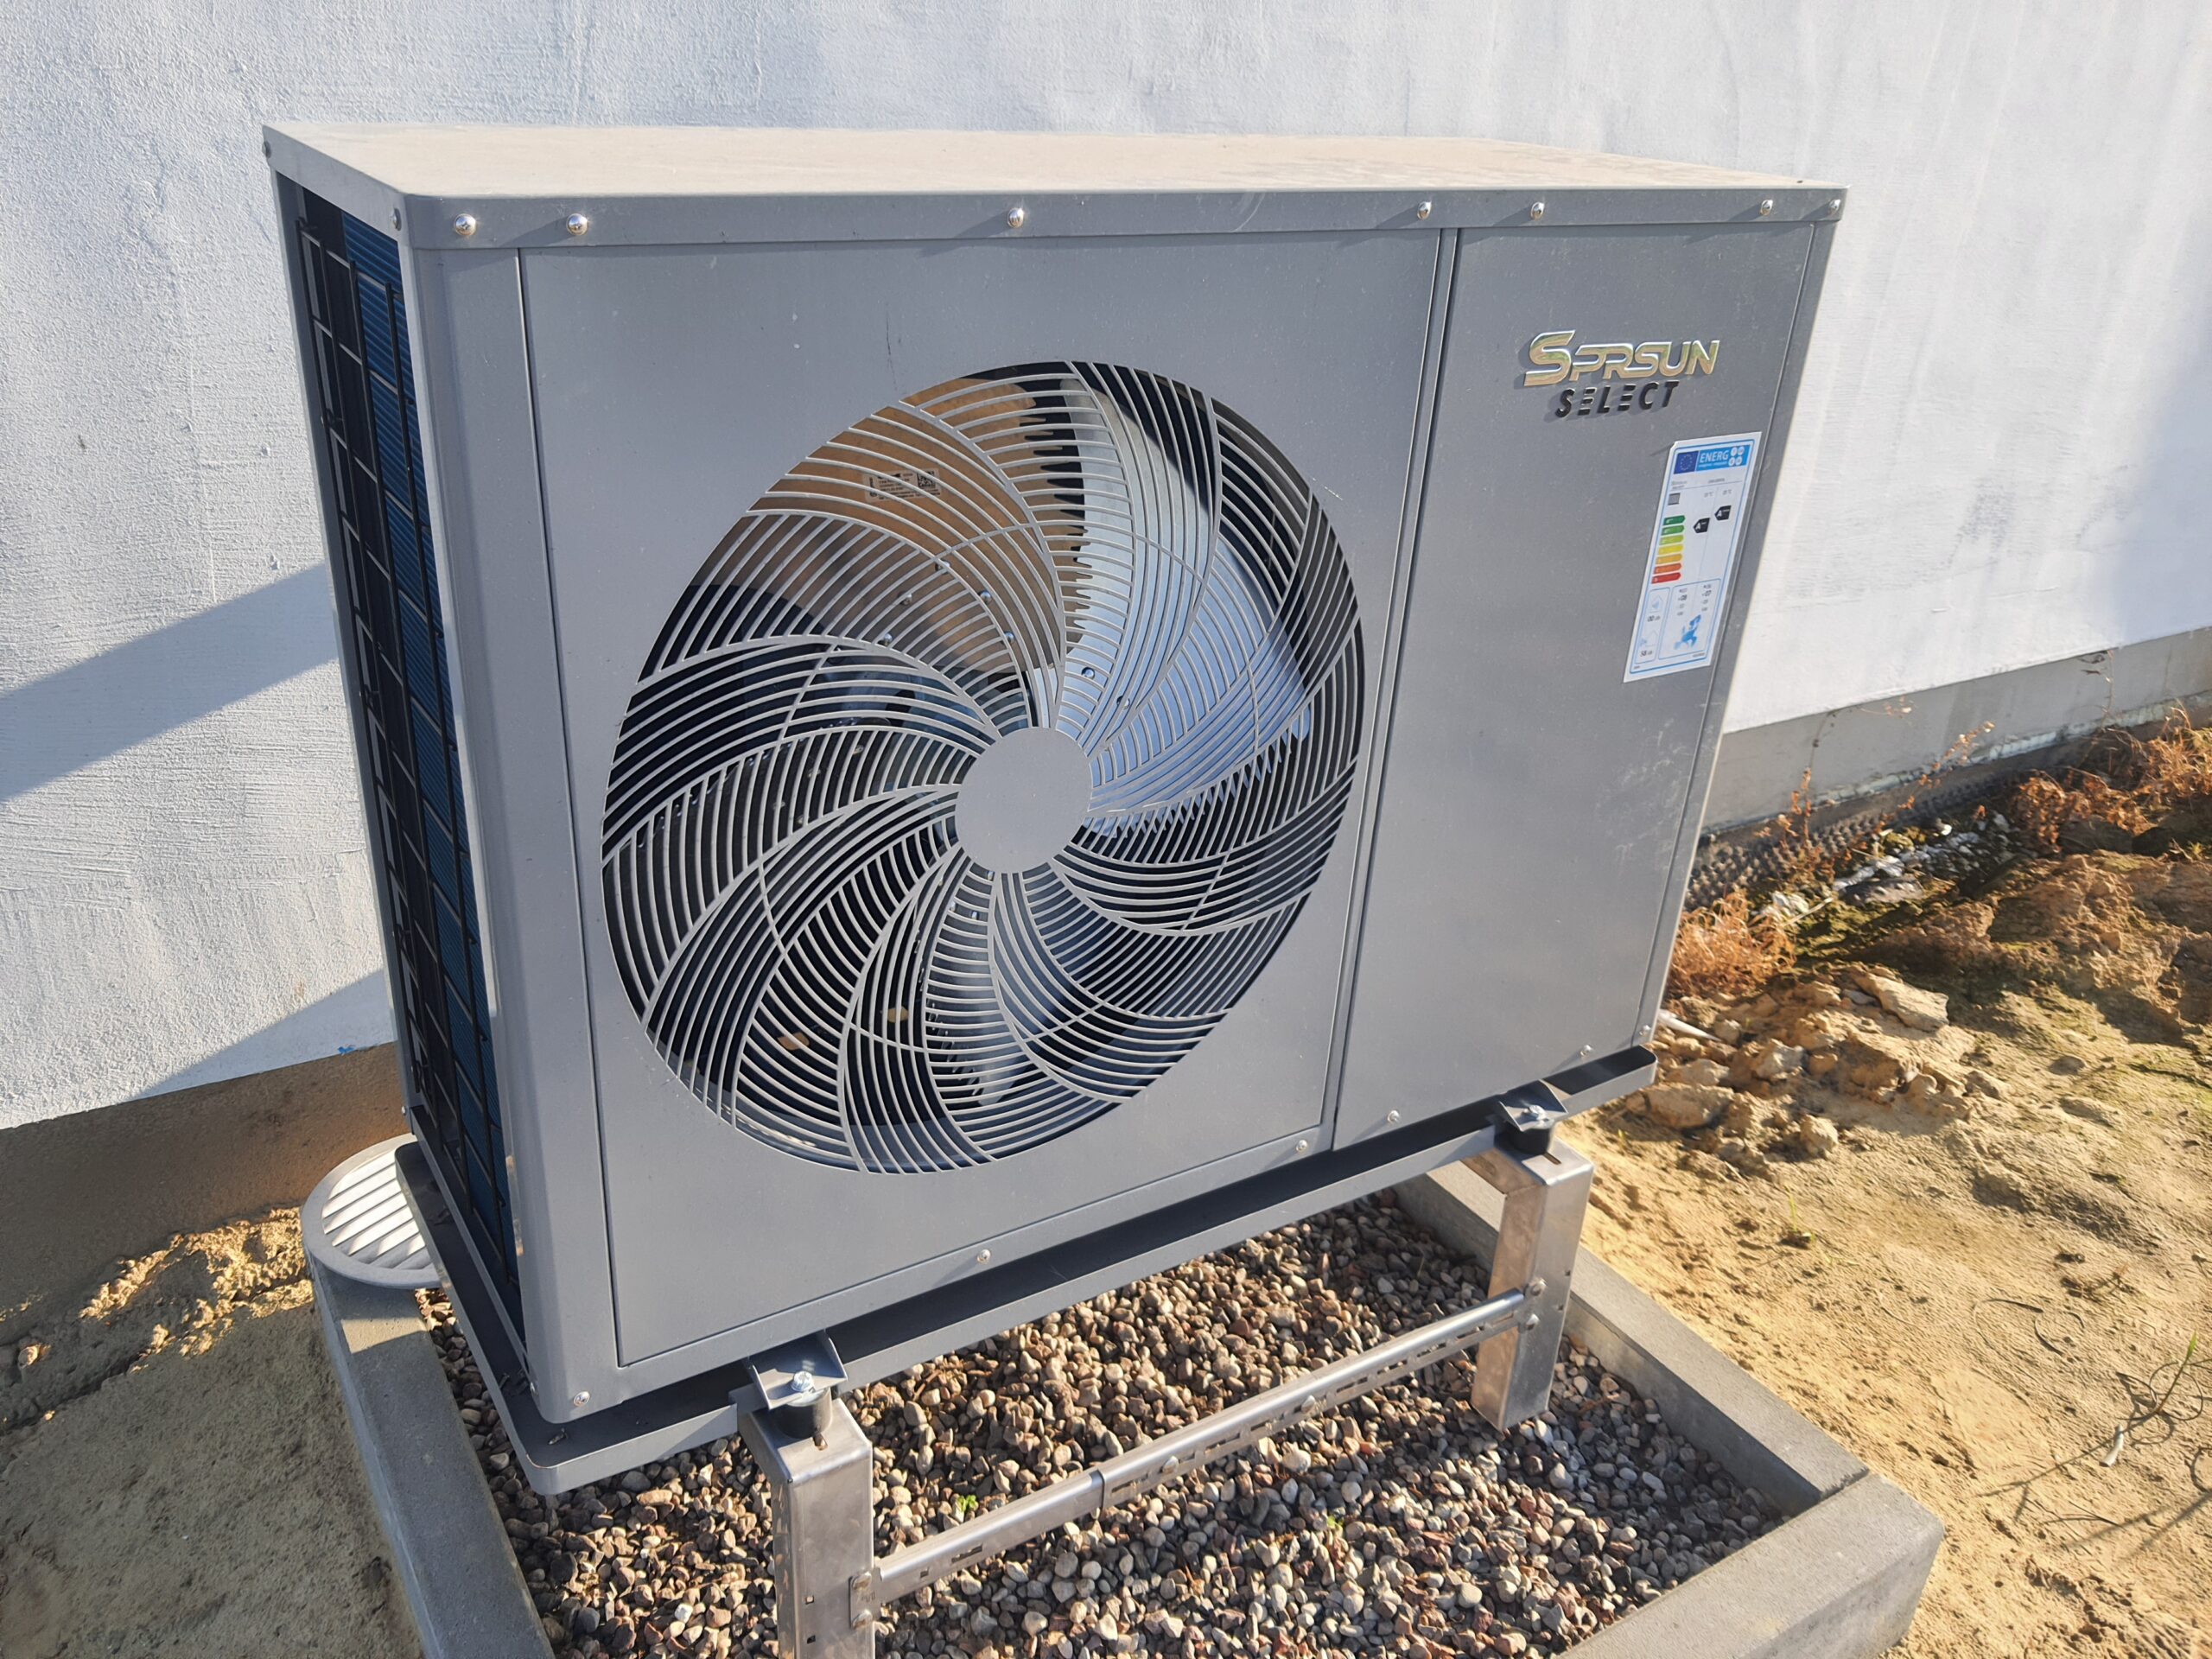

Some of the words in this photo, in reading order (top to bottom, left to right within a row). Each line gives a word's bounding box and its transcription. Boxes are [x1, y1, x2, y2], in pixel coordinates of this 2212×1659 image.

[1524, 329, 1719, 386] SPRSUN
[1554, 380, 1680, 417] SELECT
[1700, 449, 1730, 463] ENERG
